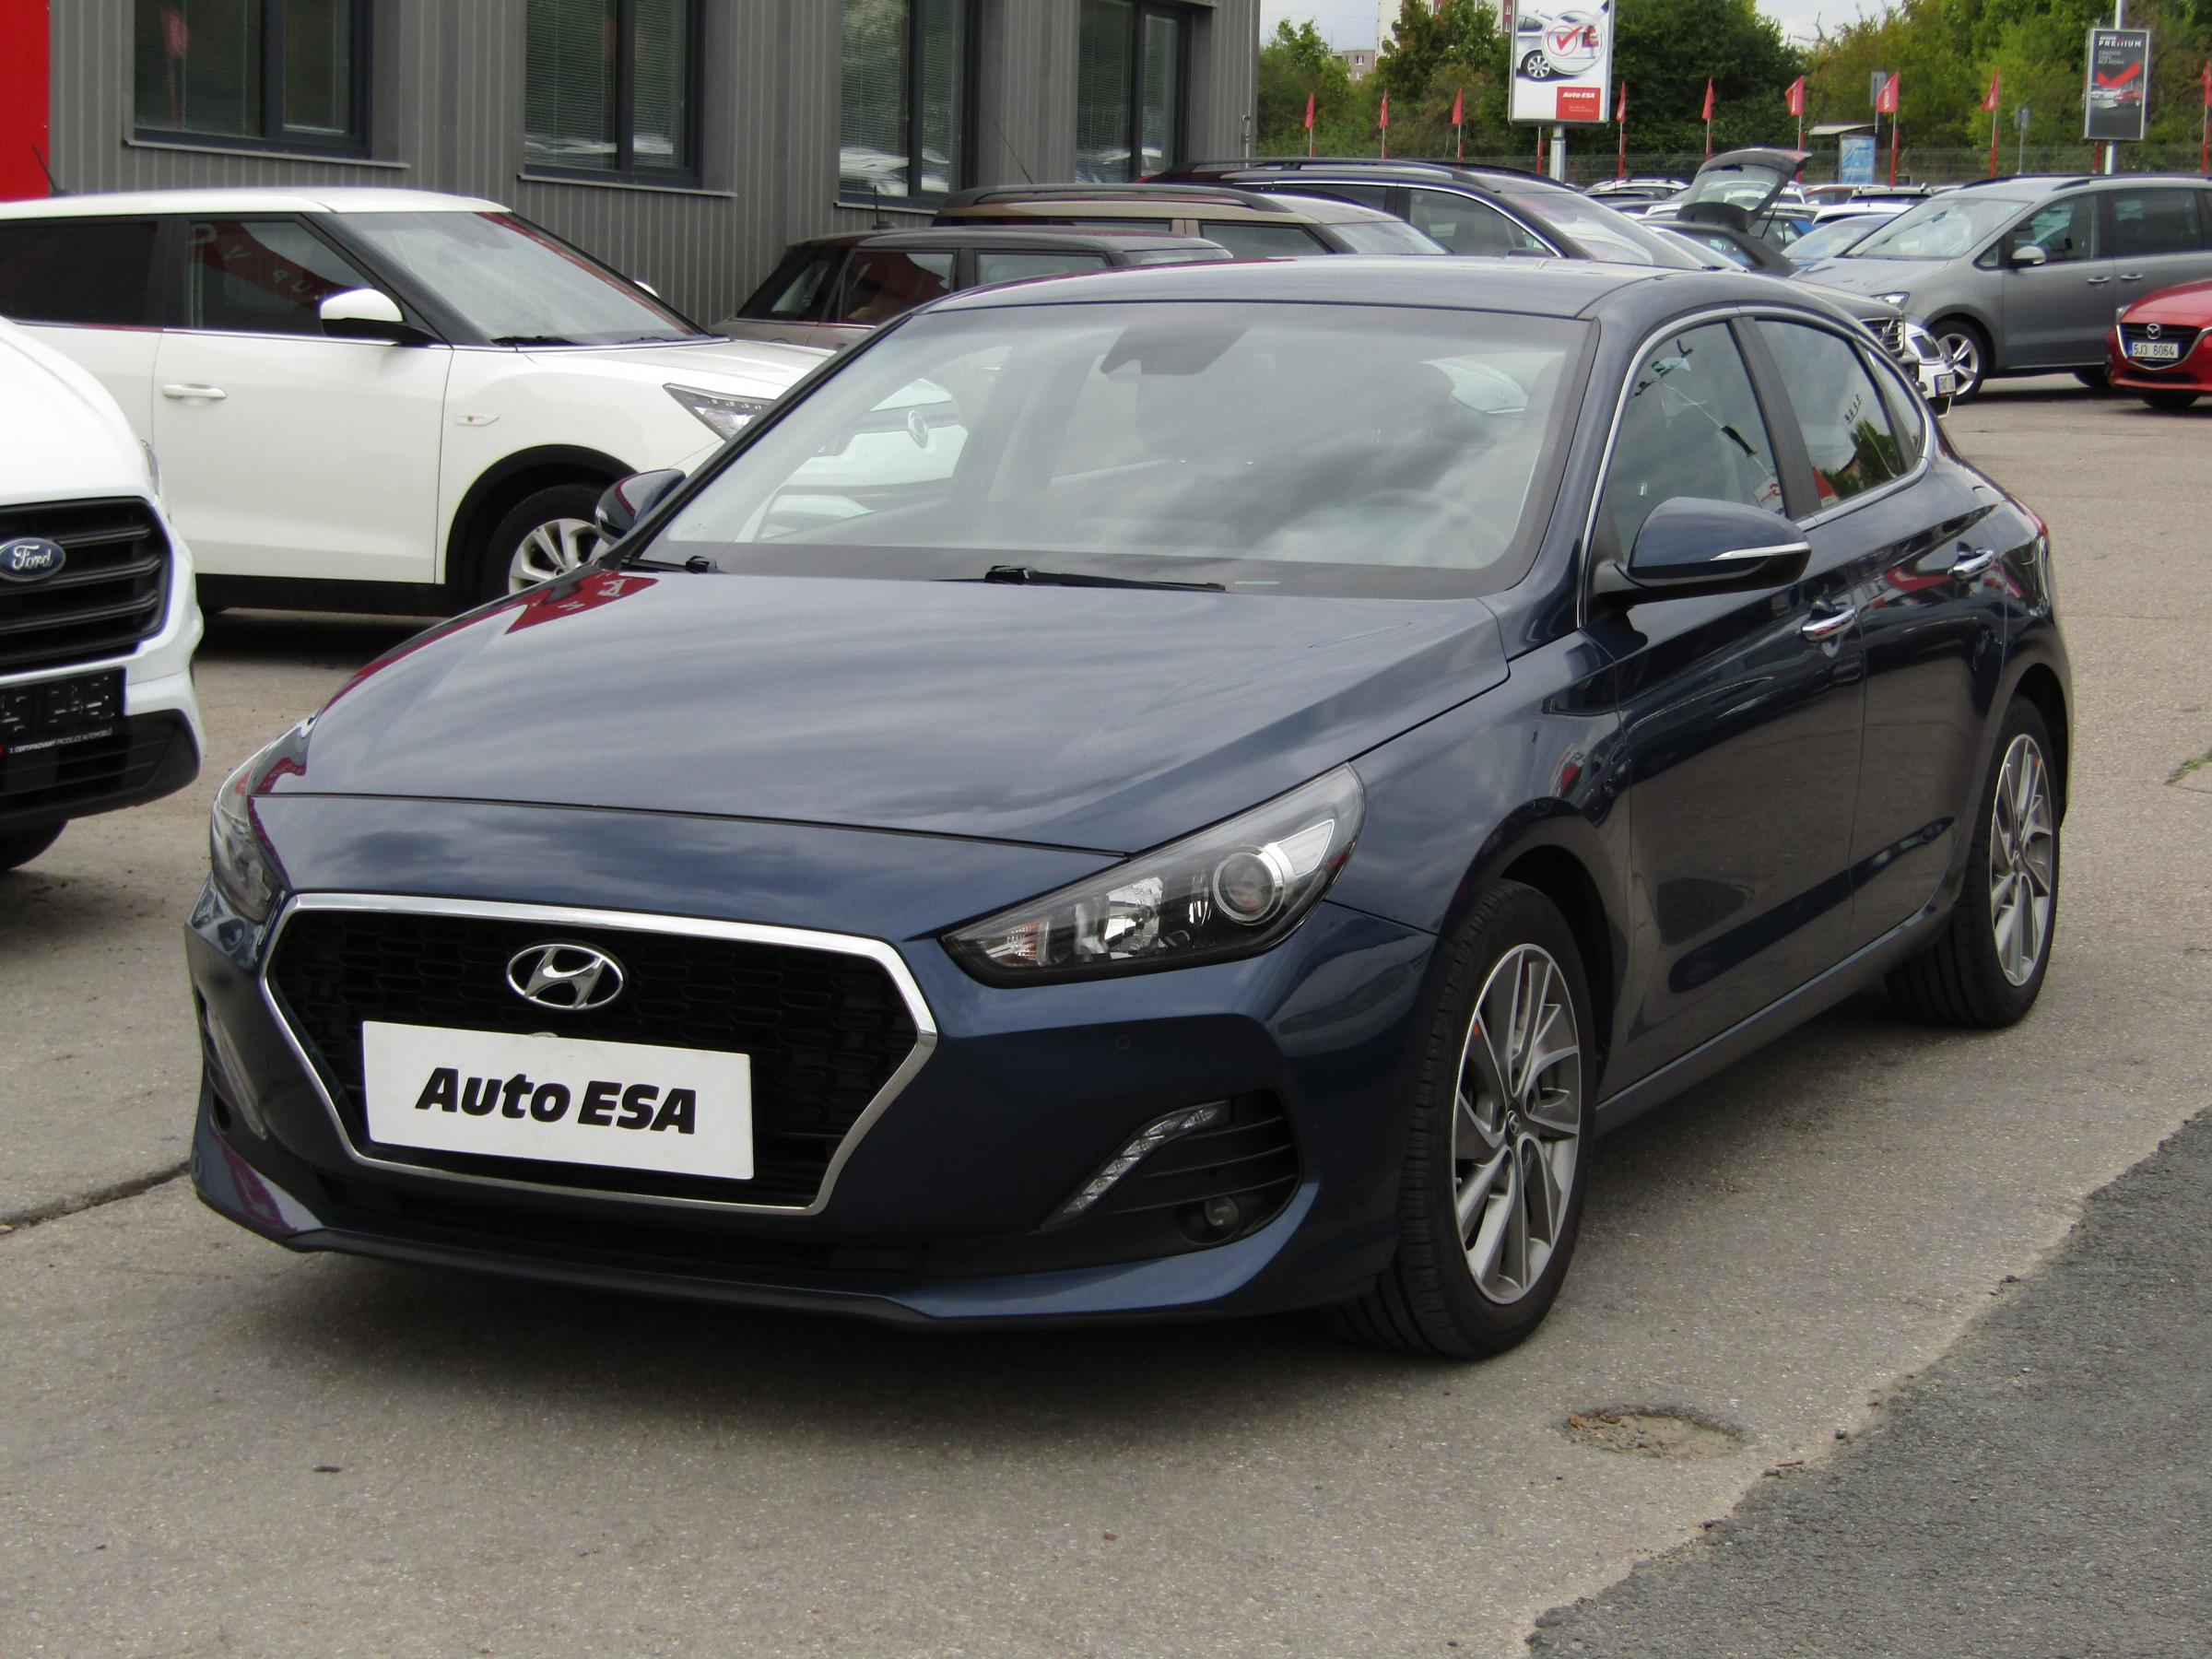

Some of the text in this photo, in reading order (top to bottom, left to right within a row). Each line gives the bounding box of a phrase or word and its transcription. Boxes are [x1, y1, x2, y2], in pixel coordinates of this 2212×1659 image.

[2134, 344, 2174, 357] 5J3 6064
[12, 545, 53, 571] Ford
[416, 1066, 697, 1135] Auto ESA
